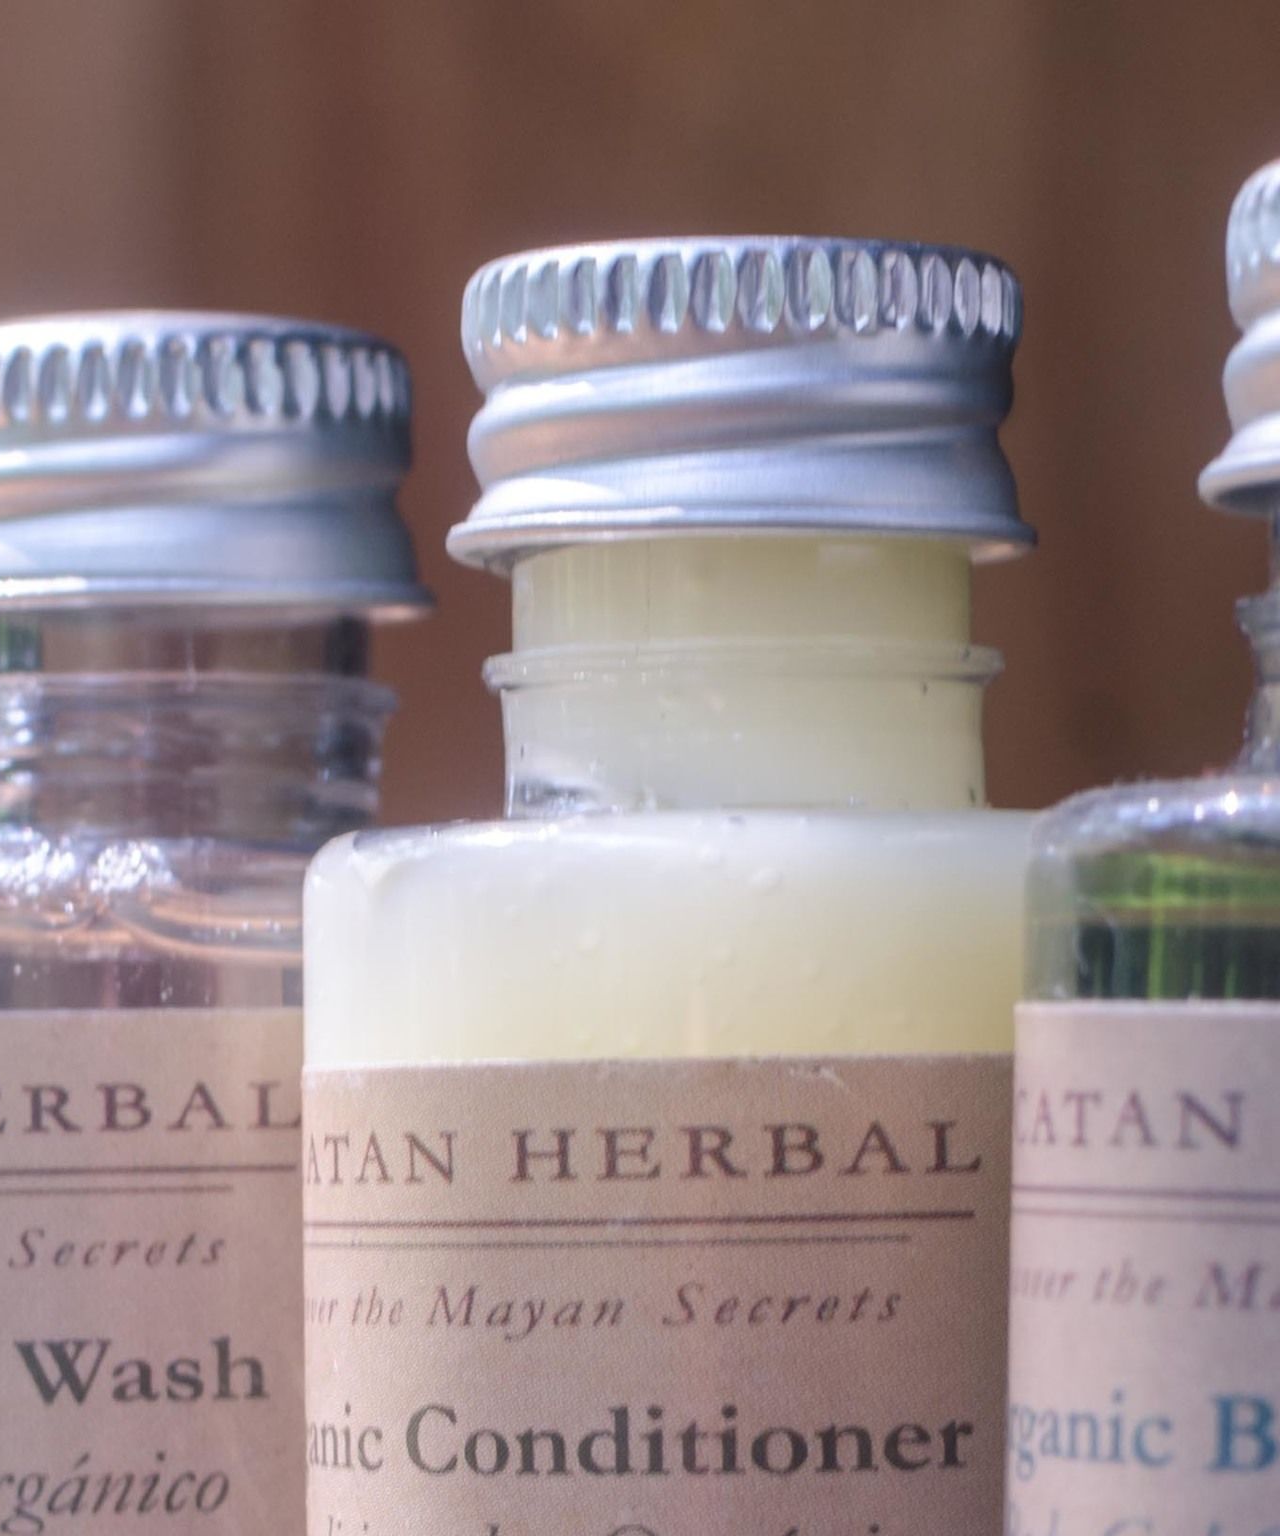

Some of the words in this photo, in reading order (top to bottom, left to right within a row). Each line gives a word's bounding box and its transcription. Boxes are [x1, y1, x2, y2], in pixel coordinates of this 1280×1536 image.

[510, 1121, 983, 1181] HERBAL
[8, 1228, 225, 1270] Secrets
[1094, 1259, 1167, 1304] the
[351, 1286, 403, 1326] the
[425, 1284, 626, 1342] Mayan
[663, 1283, 904, 1327] Secrets
[14, 1336, 270, 1407] Wash
[406, 1404, 974, 1476] Conditioner
